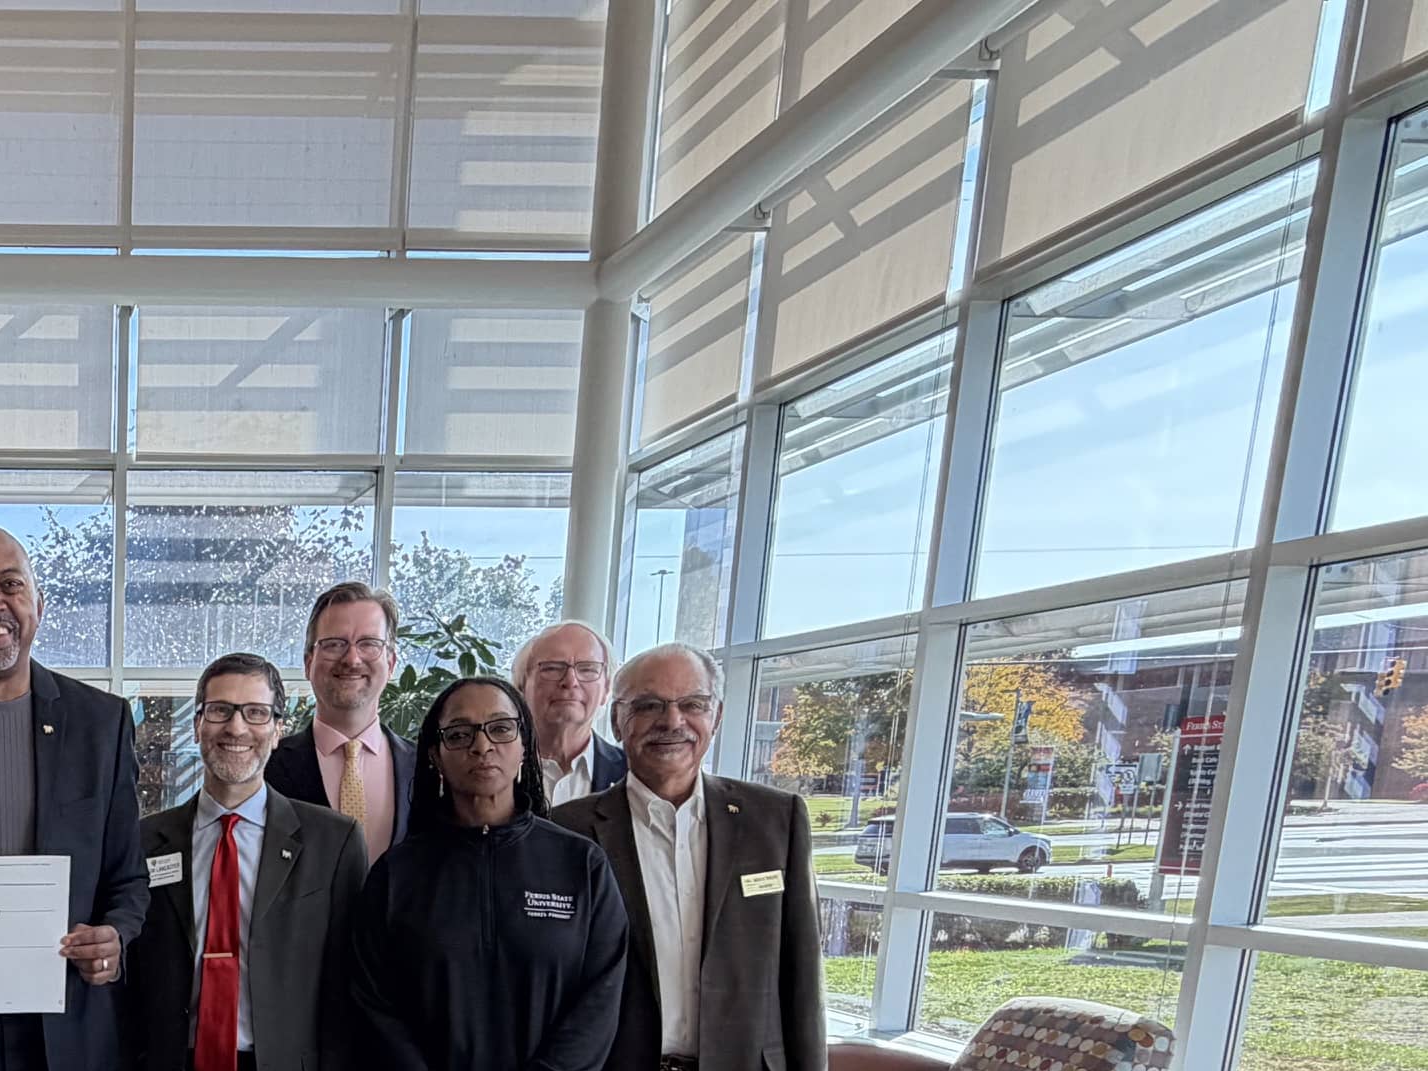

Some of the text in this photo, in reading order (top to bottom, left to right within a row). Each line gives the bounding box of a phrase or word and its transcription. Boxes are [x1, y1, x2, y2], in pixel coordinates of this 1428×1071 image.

[524, 890, 574, 902] FERRIS STATE
[527, 898, 572, 909] UNIVERSITY
